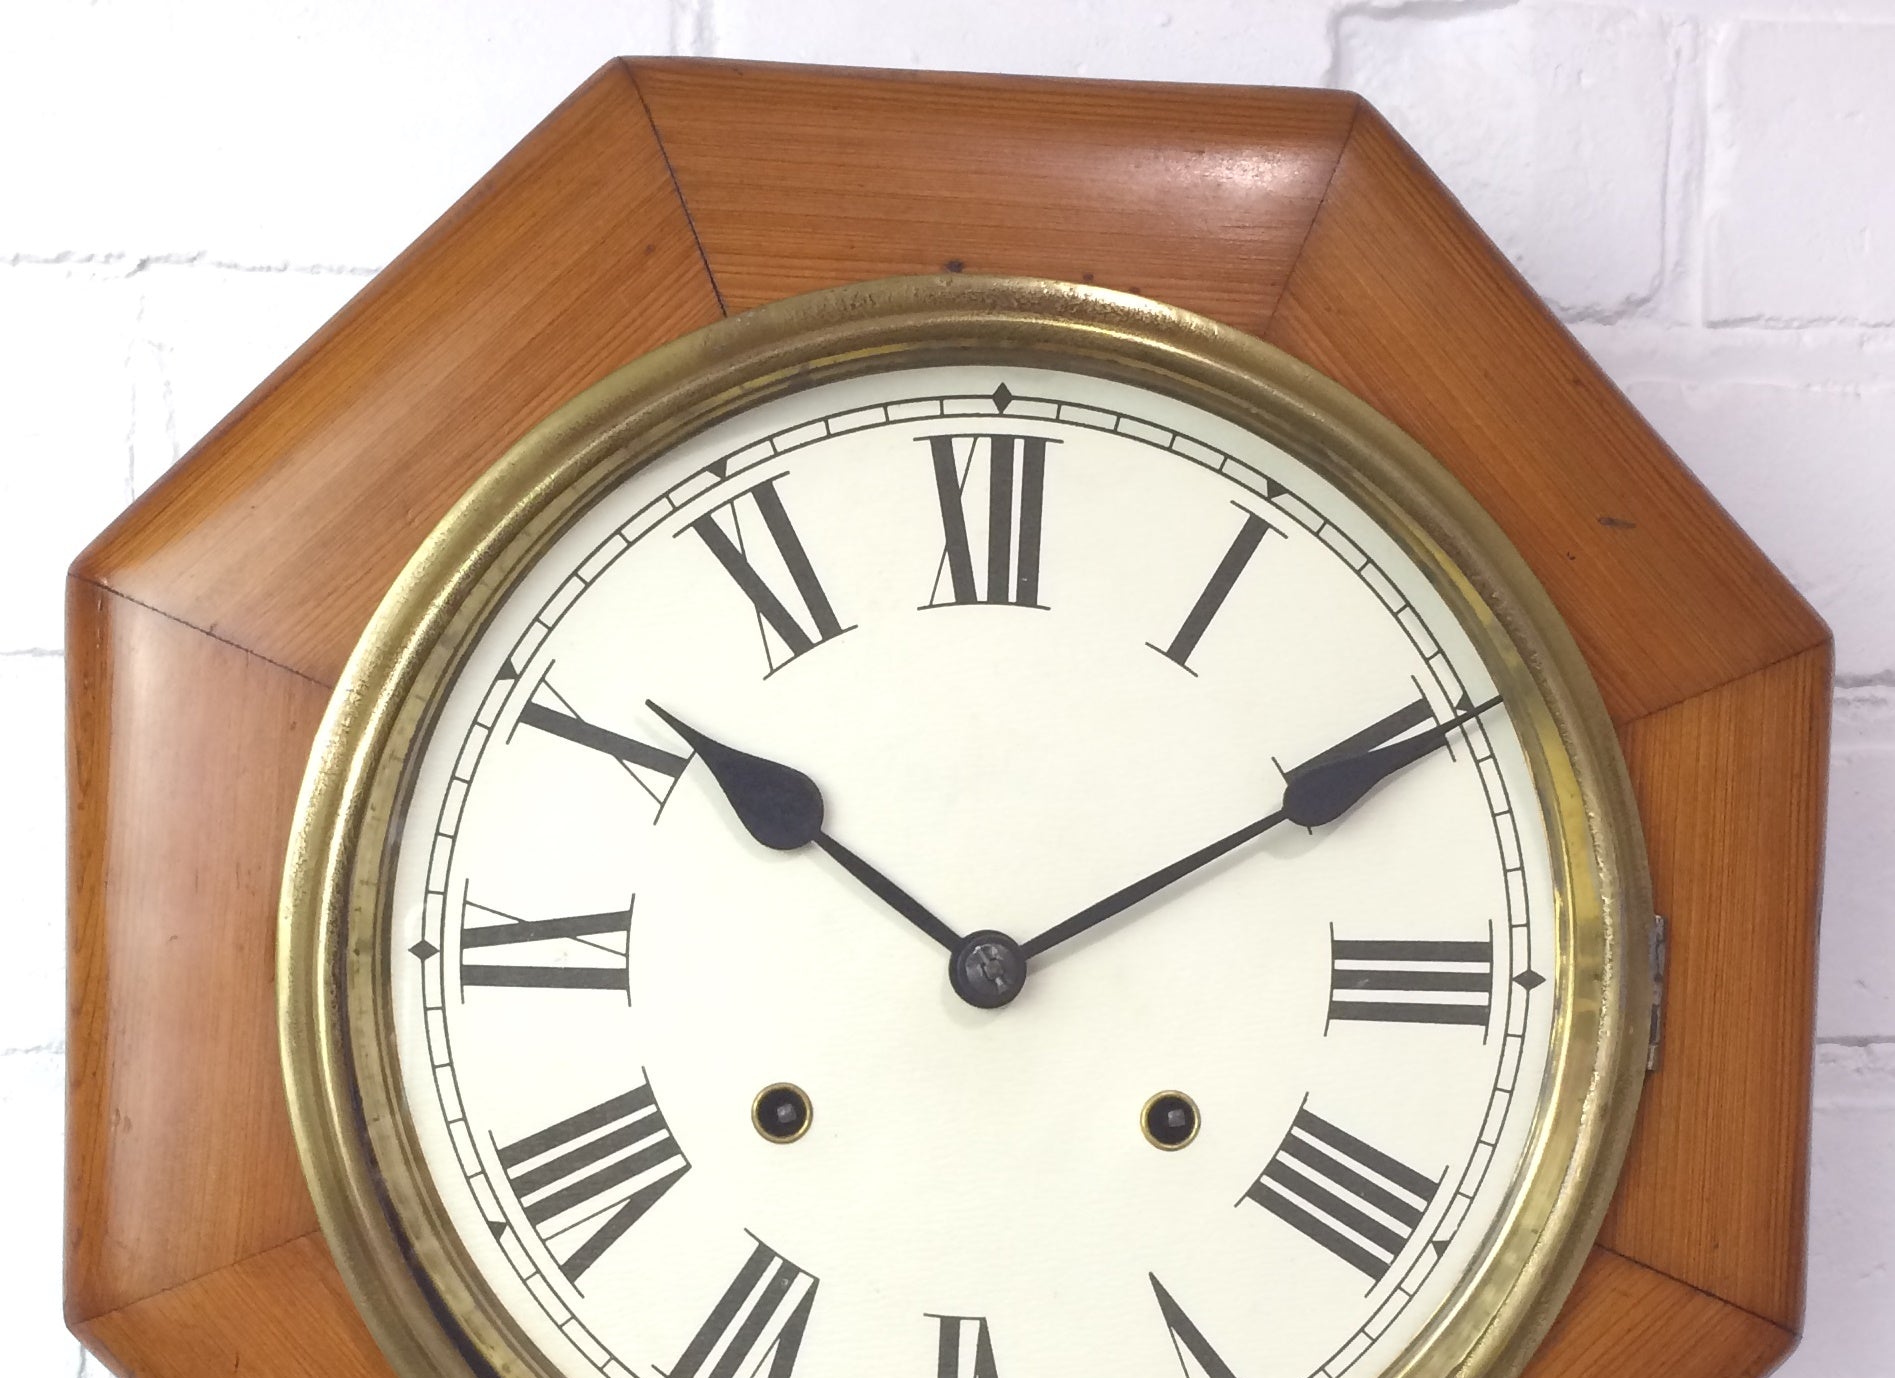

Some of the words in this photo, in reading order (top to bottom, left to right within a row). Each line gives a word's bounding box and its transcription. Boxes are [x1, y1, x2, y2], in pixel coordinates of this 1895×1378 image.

[673, 471, 858, 680] XI
[914, 434, 1063, 610] XII
[1145, 500, 1288, 677] I
[506, 659, 697, 825] X
[1324, 919, 1494, 1045] III
